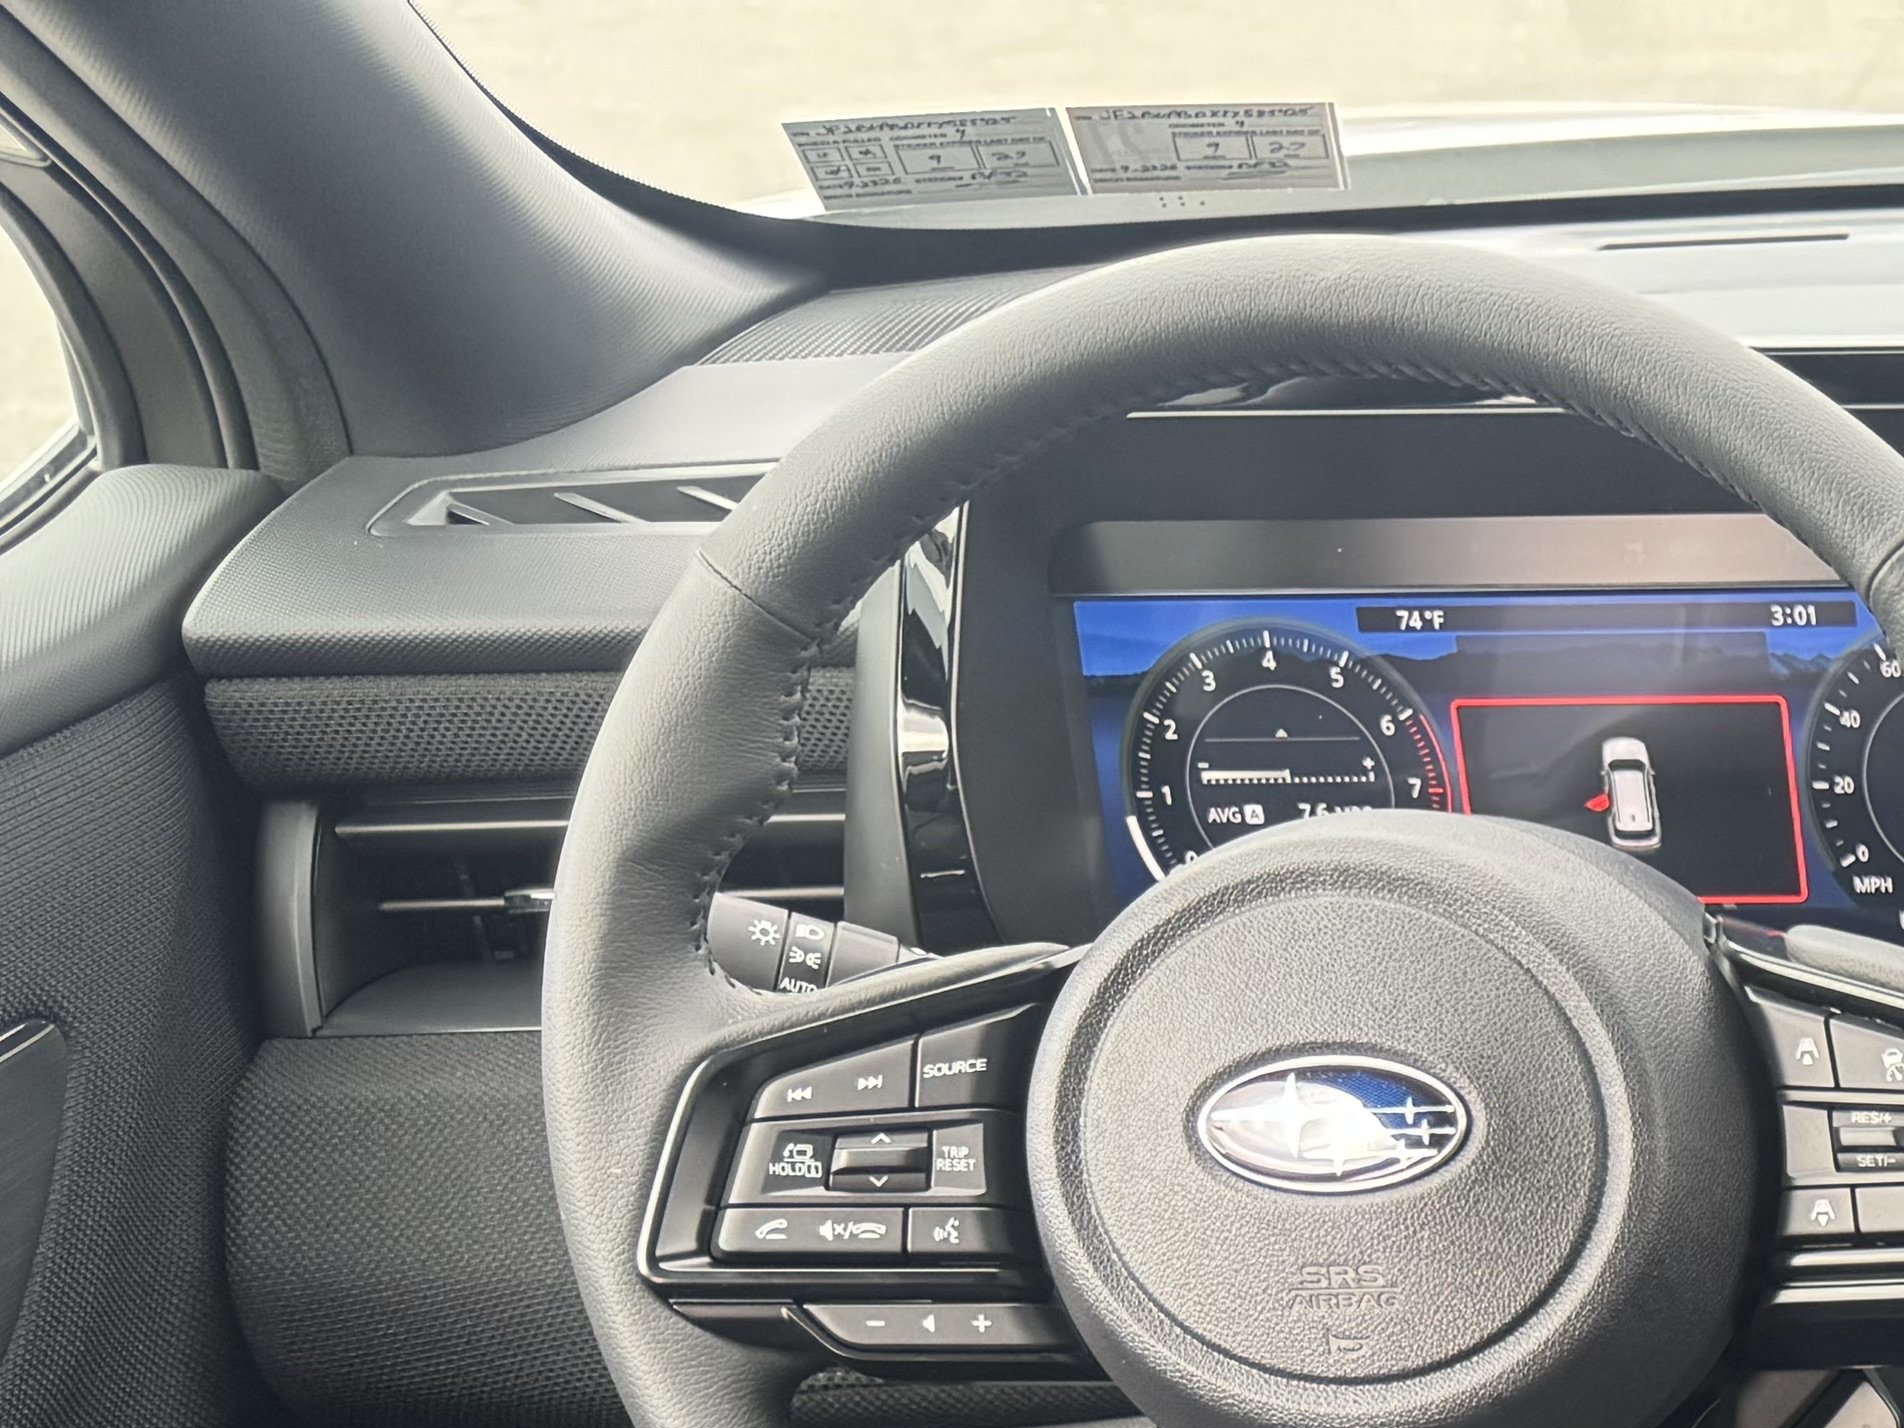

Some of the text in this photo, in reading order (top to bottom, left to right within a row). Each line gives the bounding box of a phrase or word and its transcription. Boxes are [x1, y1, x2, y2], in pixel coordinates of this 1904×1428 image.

[1771, 604, 1817, 625] 3:01
[1261, 650, 1276, 671] 4
[1880, 660, 1901, 679] 60
[1201, 670, 1217, 692] 3
[1329, 668, 1345, 689] 5
[1380, 714, 1395, 737] 6
[1840, 710, 1861, 728] 40
[1163, 719, 1178, 741] 2
[1162, 785, 1173, 806] 1
[1408, 778, 1422, 799] 7
[1833, 776, 1854, 795] 20
[1207, 806, 1242, 823] AVG
[1857, 843, 1870, 863] 0
[1852, 875, 1893, 894] MPH
[779, 977, 818, 994] AUTO
[923, 1059, 988, 1079] SOURCE
[942, 1146, 969, 1160] TRIP
[768, 1162, 806, 1177] HOLD
[936, 1158, 976, 1173] RESET
[1300, 1265, 1384, 1288] SRS
